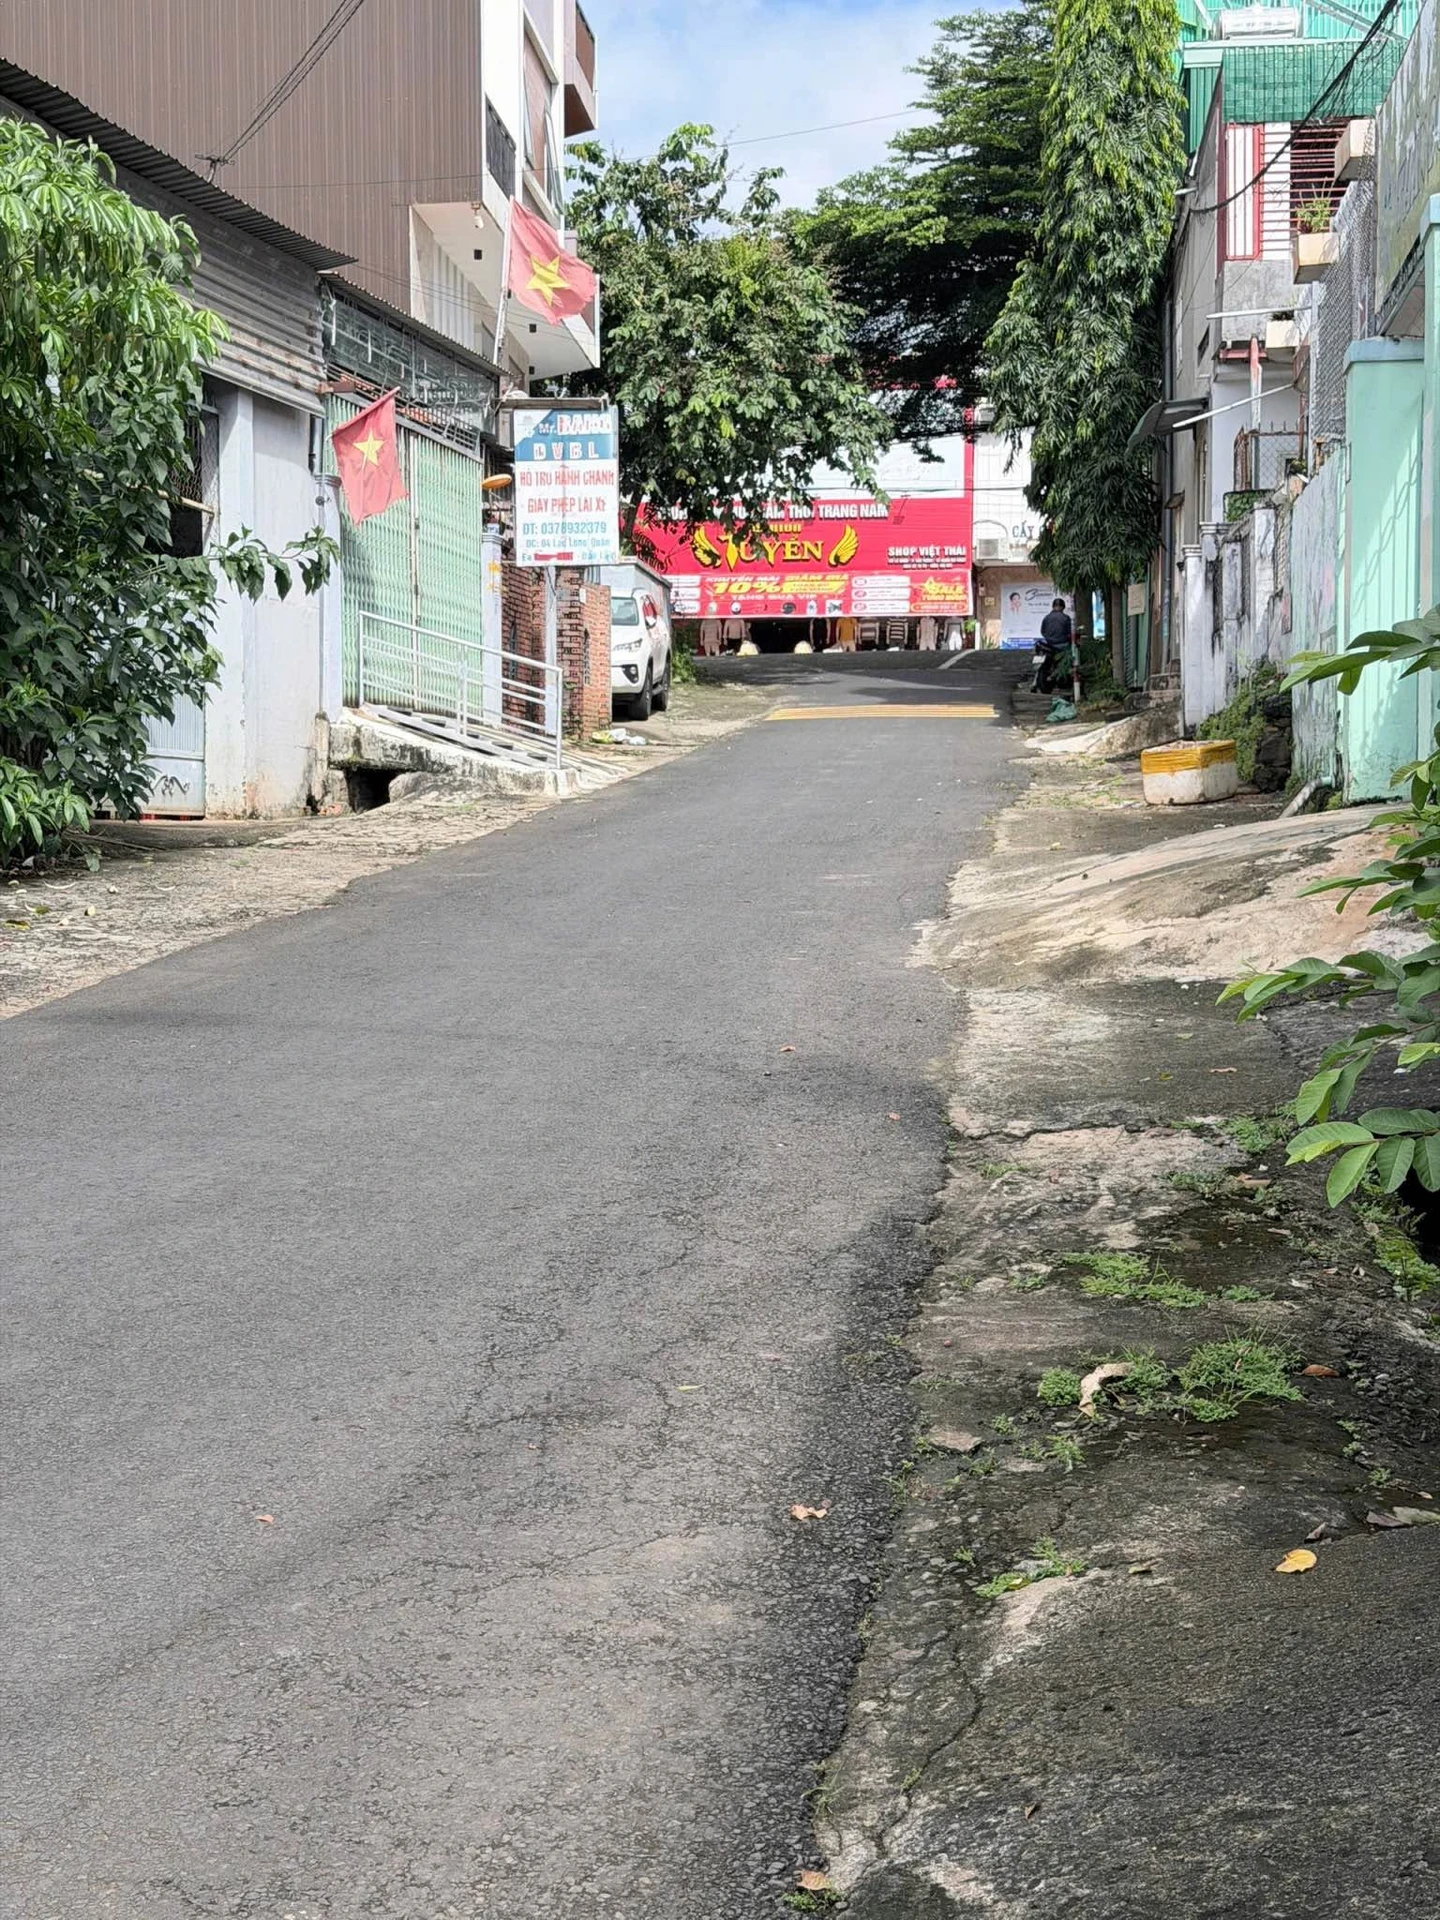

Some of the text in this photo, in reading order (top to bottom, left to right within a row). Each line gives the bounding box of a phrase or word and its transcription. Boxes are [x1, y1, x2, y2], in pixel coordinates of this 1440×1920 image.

[818, 504, 858, 518] TRANG
[860, 503, 888, 518] NAM
[888, 546, 916, 557] SHOP
[712, 581, 780, 595] 10%
